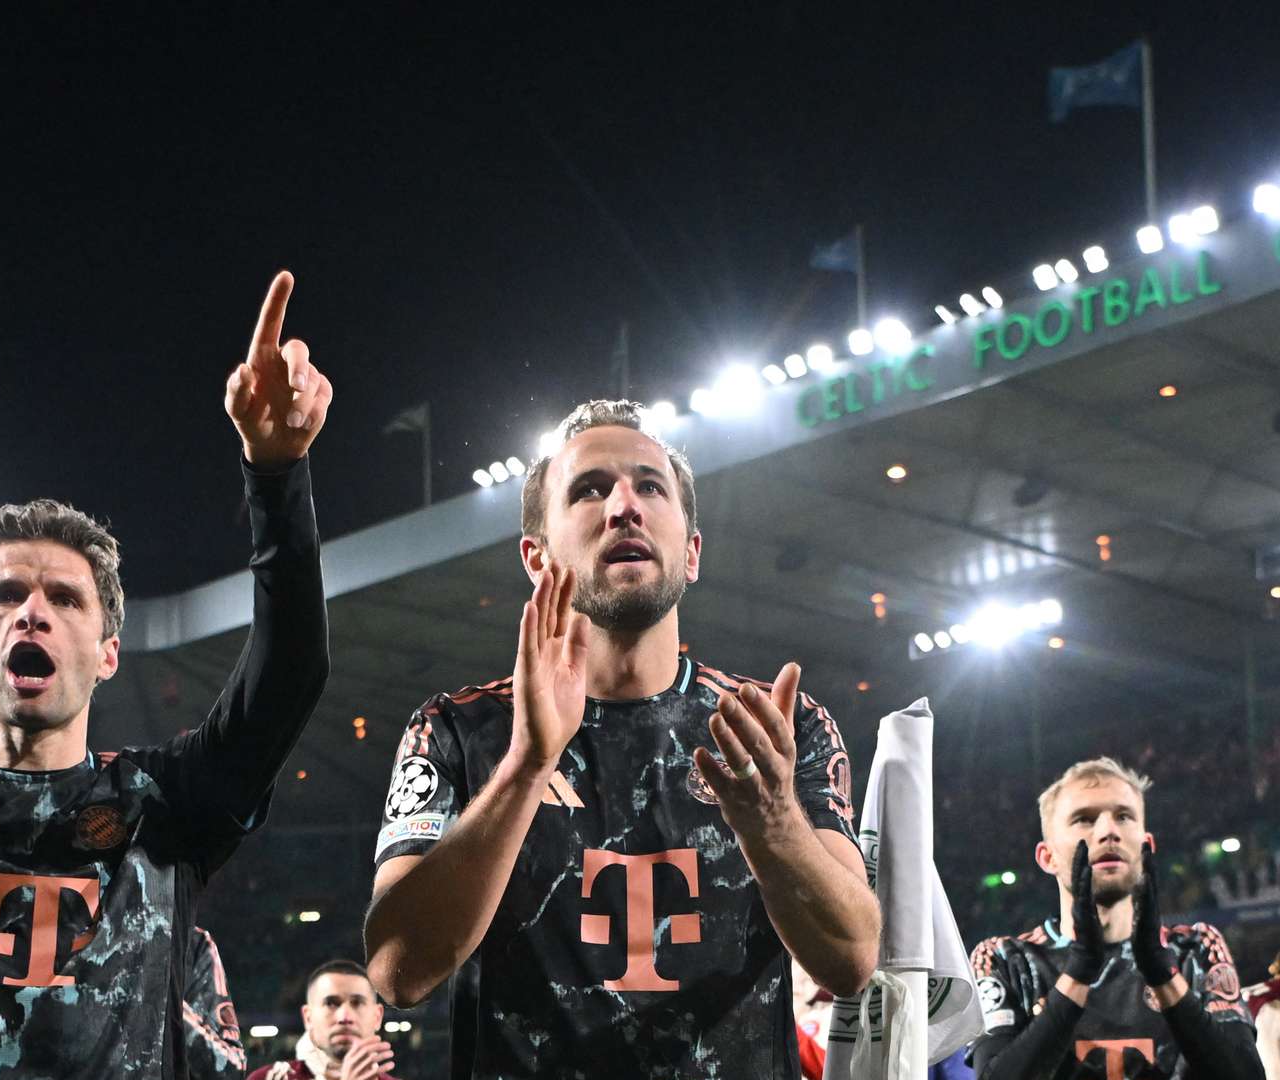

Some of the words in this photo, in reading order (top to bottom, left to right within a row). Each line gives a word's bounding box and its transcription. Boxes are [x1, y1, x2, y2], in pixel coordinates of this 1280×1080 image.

[796, 343, 936, 427] CELTIC
[972, 250, 1220, 369] FOOTBALL
[580, 848, 700, 991] T
